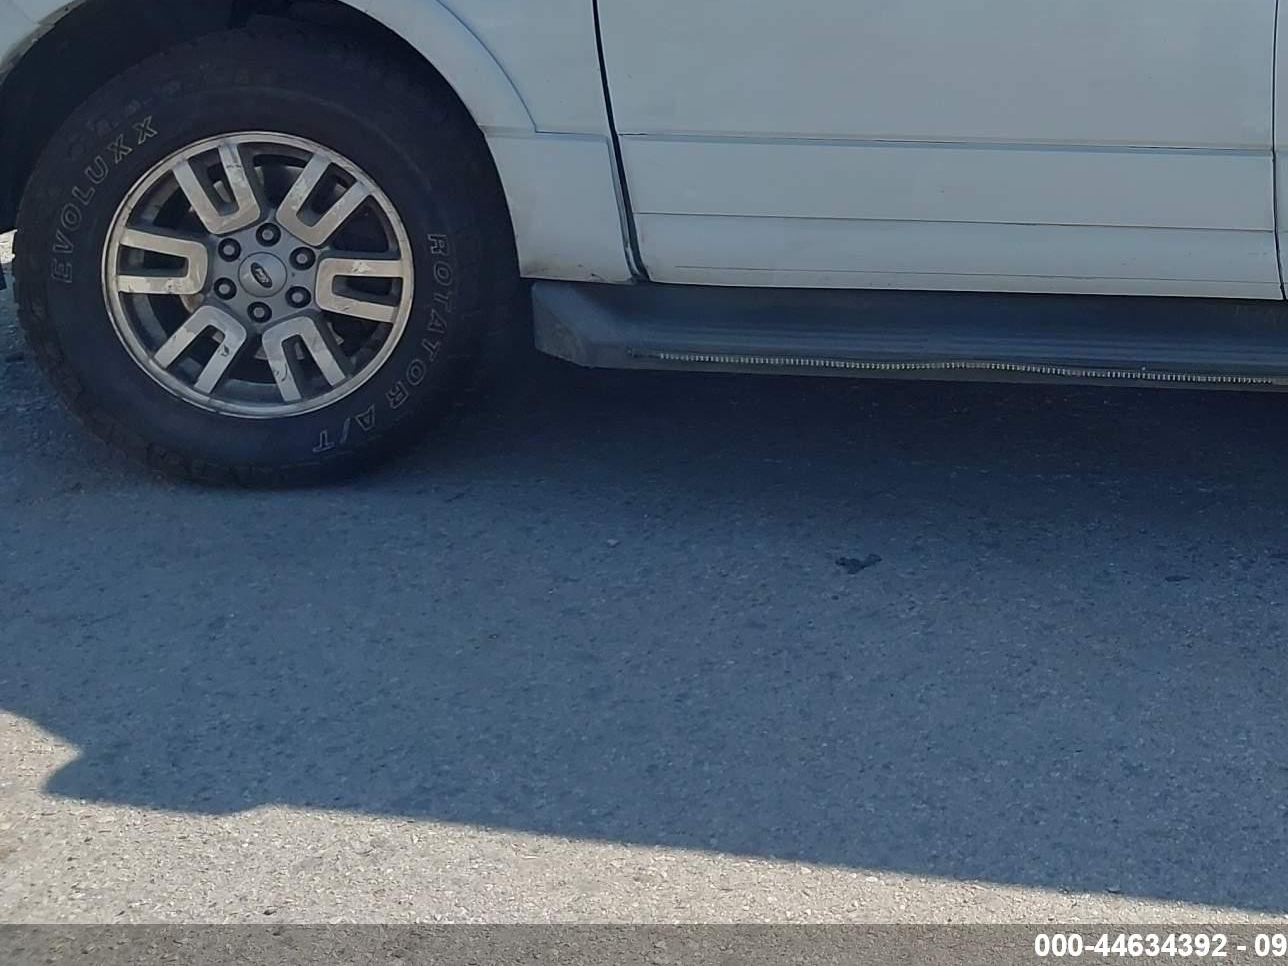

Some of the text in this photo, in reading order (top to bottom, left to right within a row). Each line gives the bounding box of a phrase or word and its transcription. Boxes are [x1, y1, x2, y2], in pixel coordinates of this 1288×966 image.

[50, 114, 160, 284] EVOLUXX
[312, 233, 456, 454] ROTATOR A/T
